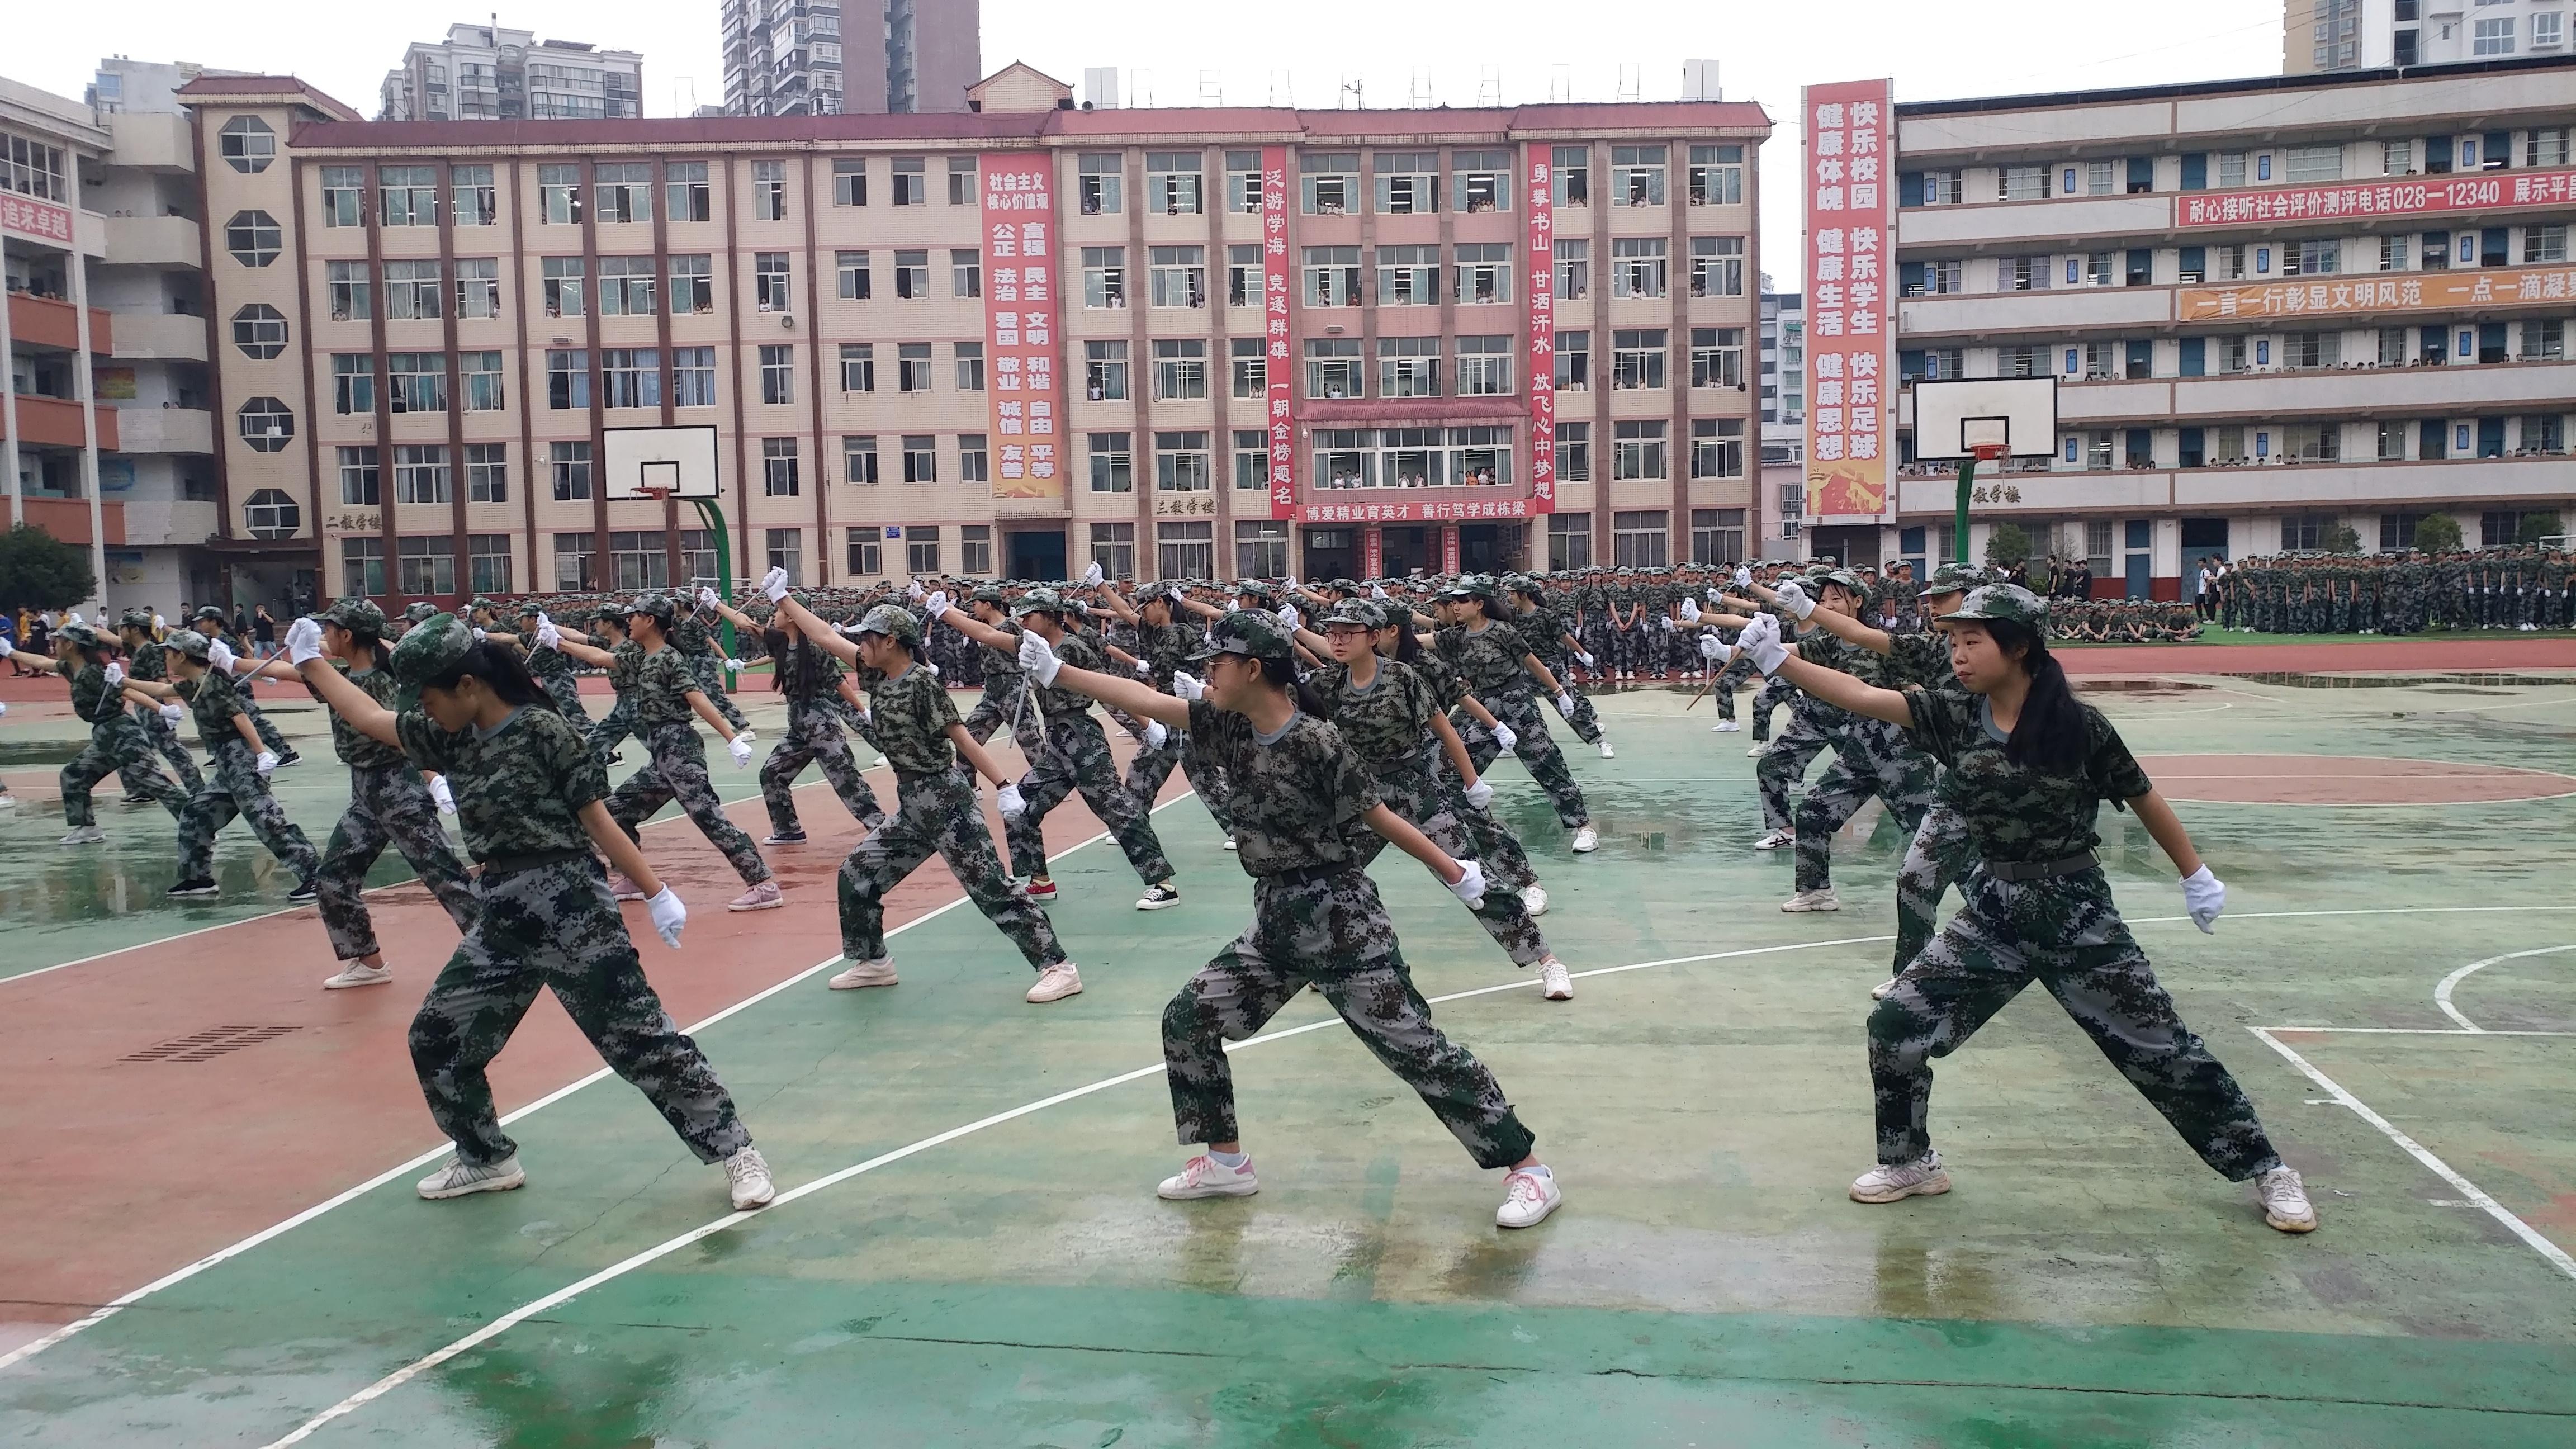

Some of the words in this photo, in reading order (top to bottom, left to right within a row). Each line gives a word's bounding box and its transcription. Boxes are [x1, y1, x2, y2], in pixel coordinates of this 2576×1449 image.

[1816, 102, 1844, 211] 健康体魄
[1849, 101, 1878, 210] 快乐校园
[989, 172, 1044, 192] 社会主义
[987, 192, 1049, 210] 核心价值观
[1265, 169, 1286, 255] 泛游学海
[1530, 163, 1550, 251] 勇攀书山
[3, 200, 68, 239] 追求卓越
[992, 223, 1016, 257] 公正
[1022, 222, 1046, 257] 富强
[993, 268, 1018, 301] 法治
[1024, 267, 1048, 301] 民主
[1816, 228, 1844, 336] 健康生活
[1849, 226, 1878, 334] 快乐学生
[1531, 269, 1551, 354] 甘洒汗水
[2196, 281, 2422, 316] 一言一行彰显文明风范
[995, 312, 1019, 346] 爱国
[1025, 311, 1049, 345] 文明
[1267, 273, 1289, 360] 竞逐群雄
[996, 356, 1021, 390] 敬业
[1026, 356, 1050, 390] 和谐
[998, 400, 1023, 434] 诚信
[1029, 400, 1053, 434] 自由
[1815, 352, 1844, 461] 健康思想
[1849, 351, 1878, 460] 快乐足球
[1270, 383, 1292, 505] 一朝金榜题名
[1532, 373, 1552, 500] 放飞心中梦想
[1000, 444, 1024, 479] 友善
[1030, 444, 1054, 478] 平等
[326, 513, 382, 531] 二教学楼
[1157, 497, 1216, 515] 三教学楼
[1306, 504, 1410, 521] 博爱精业育英才
[1422, 501, 1526, 519] 善行笃学成栋梁
